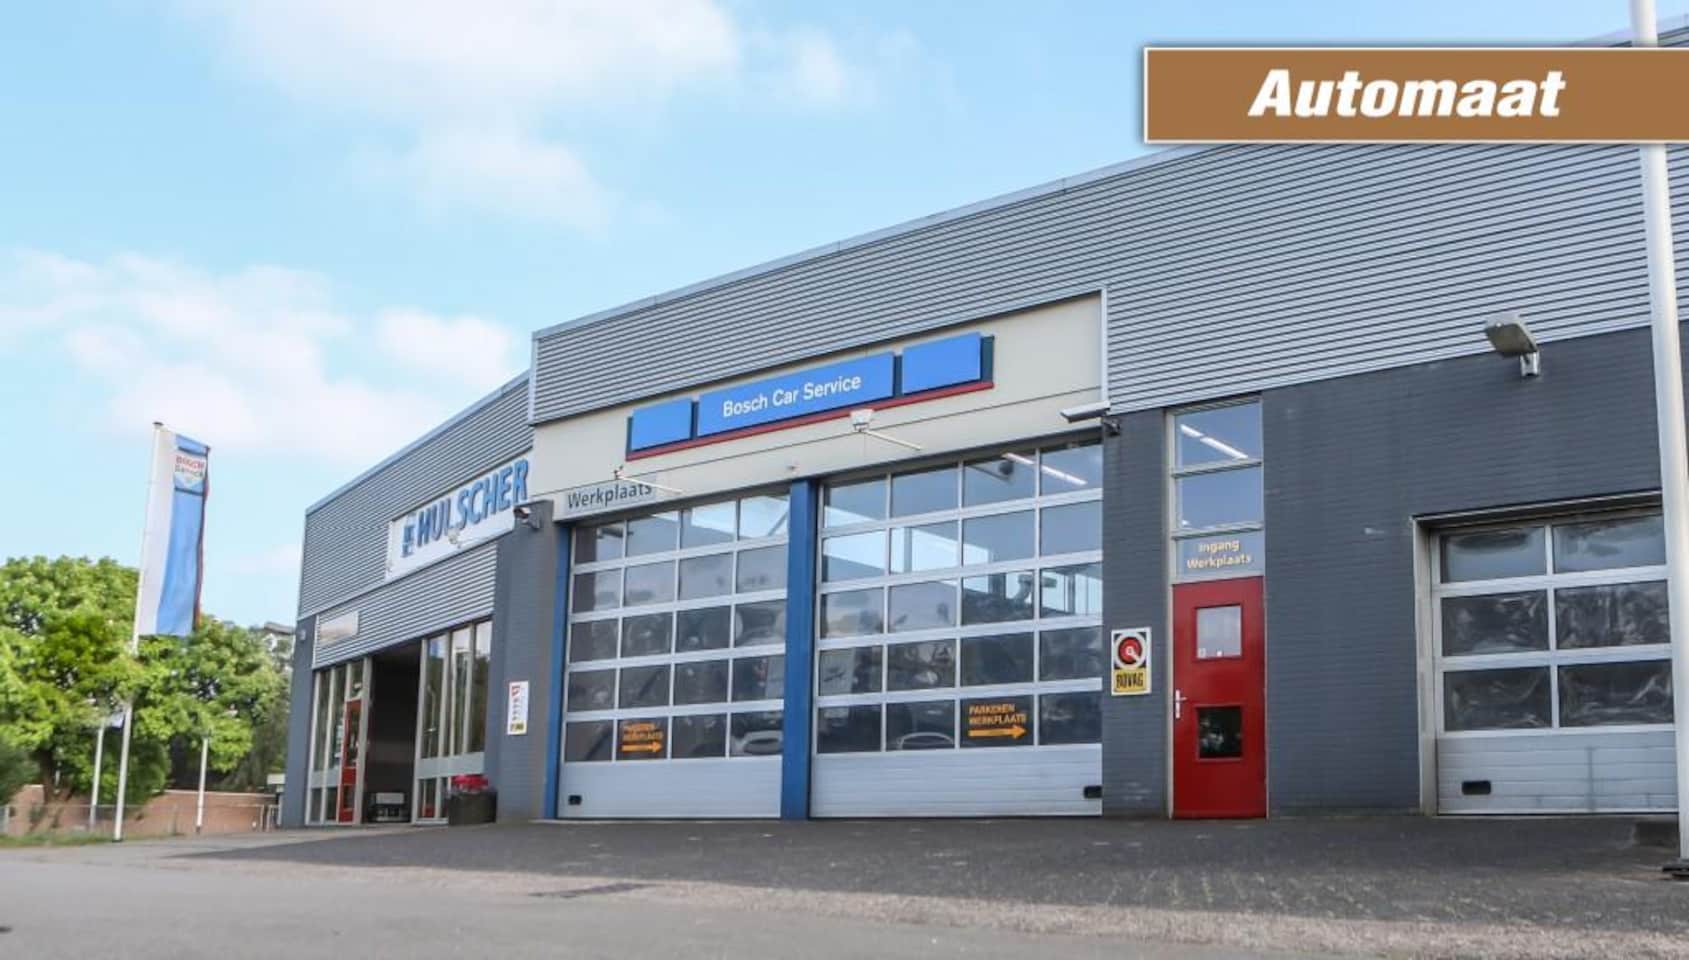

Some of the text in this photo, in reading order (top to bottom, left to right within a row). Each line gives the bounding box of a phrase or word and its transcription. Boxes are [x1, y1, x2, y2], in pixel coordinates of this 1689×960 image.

[723, 375, 861, 417] Bosch Car Service
[416, 458, 529, 548] HULSCHER
[567, 483, 652, 509] Werkplaats
[1187, 553, 1251, 569] Werkplaats
